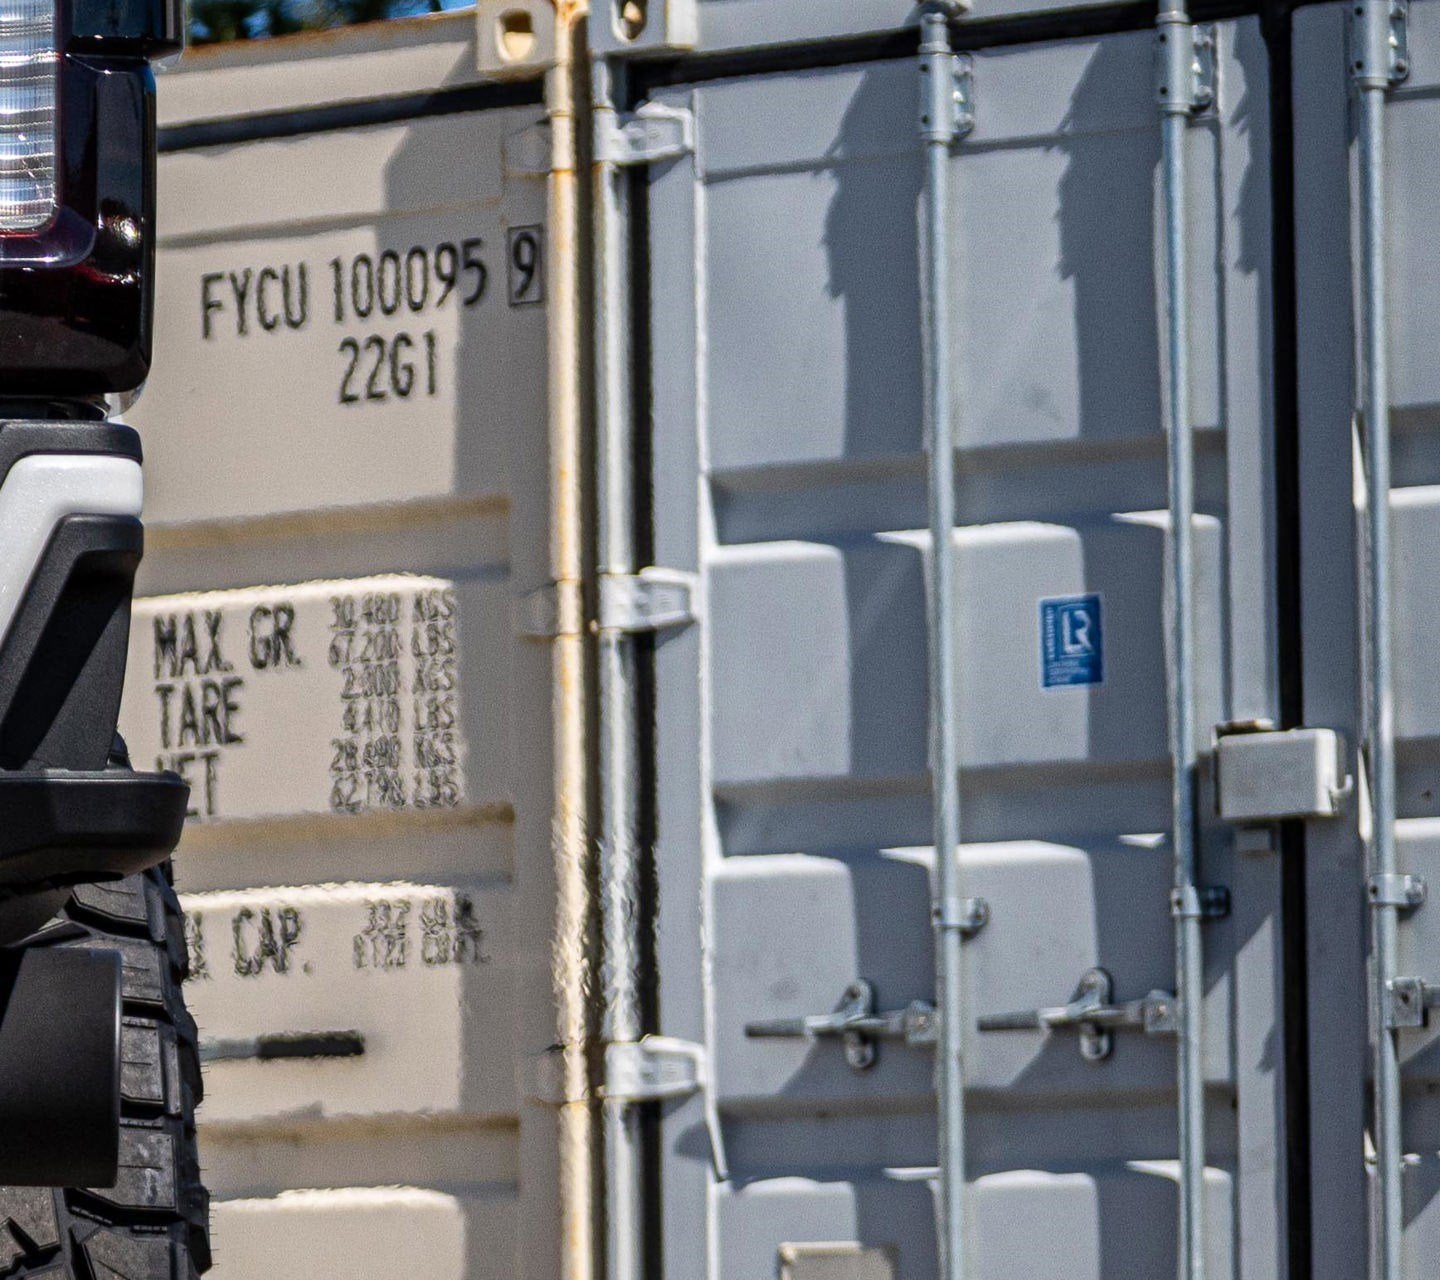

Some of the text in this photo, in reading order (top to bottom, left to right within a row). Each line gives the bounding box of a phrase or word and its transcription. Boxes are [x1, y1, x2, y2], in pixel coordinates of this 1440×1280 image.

[200, 262, 308, 340] FYCU
[330, 236, 489, 322] 100095
[338, 328, 437, 404] 22G1
[155, 675, 245, 750] TARE
